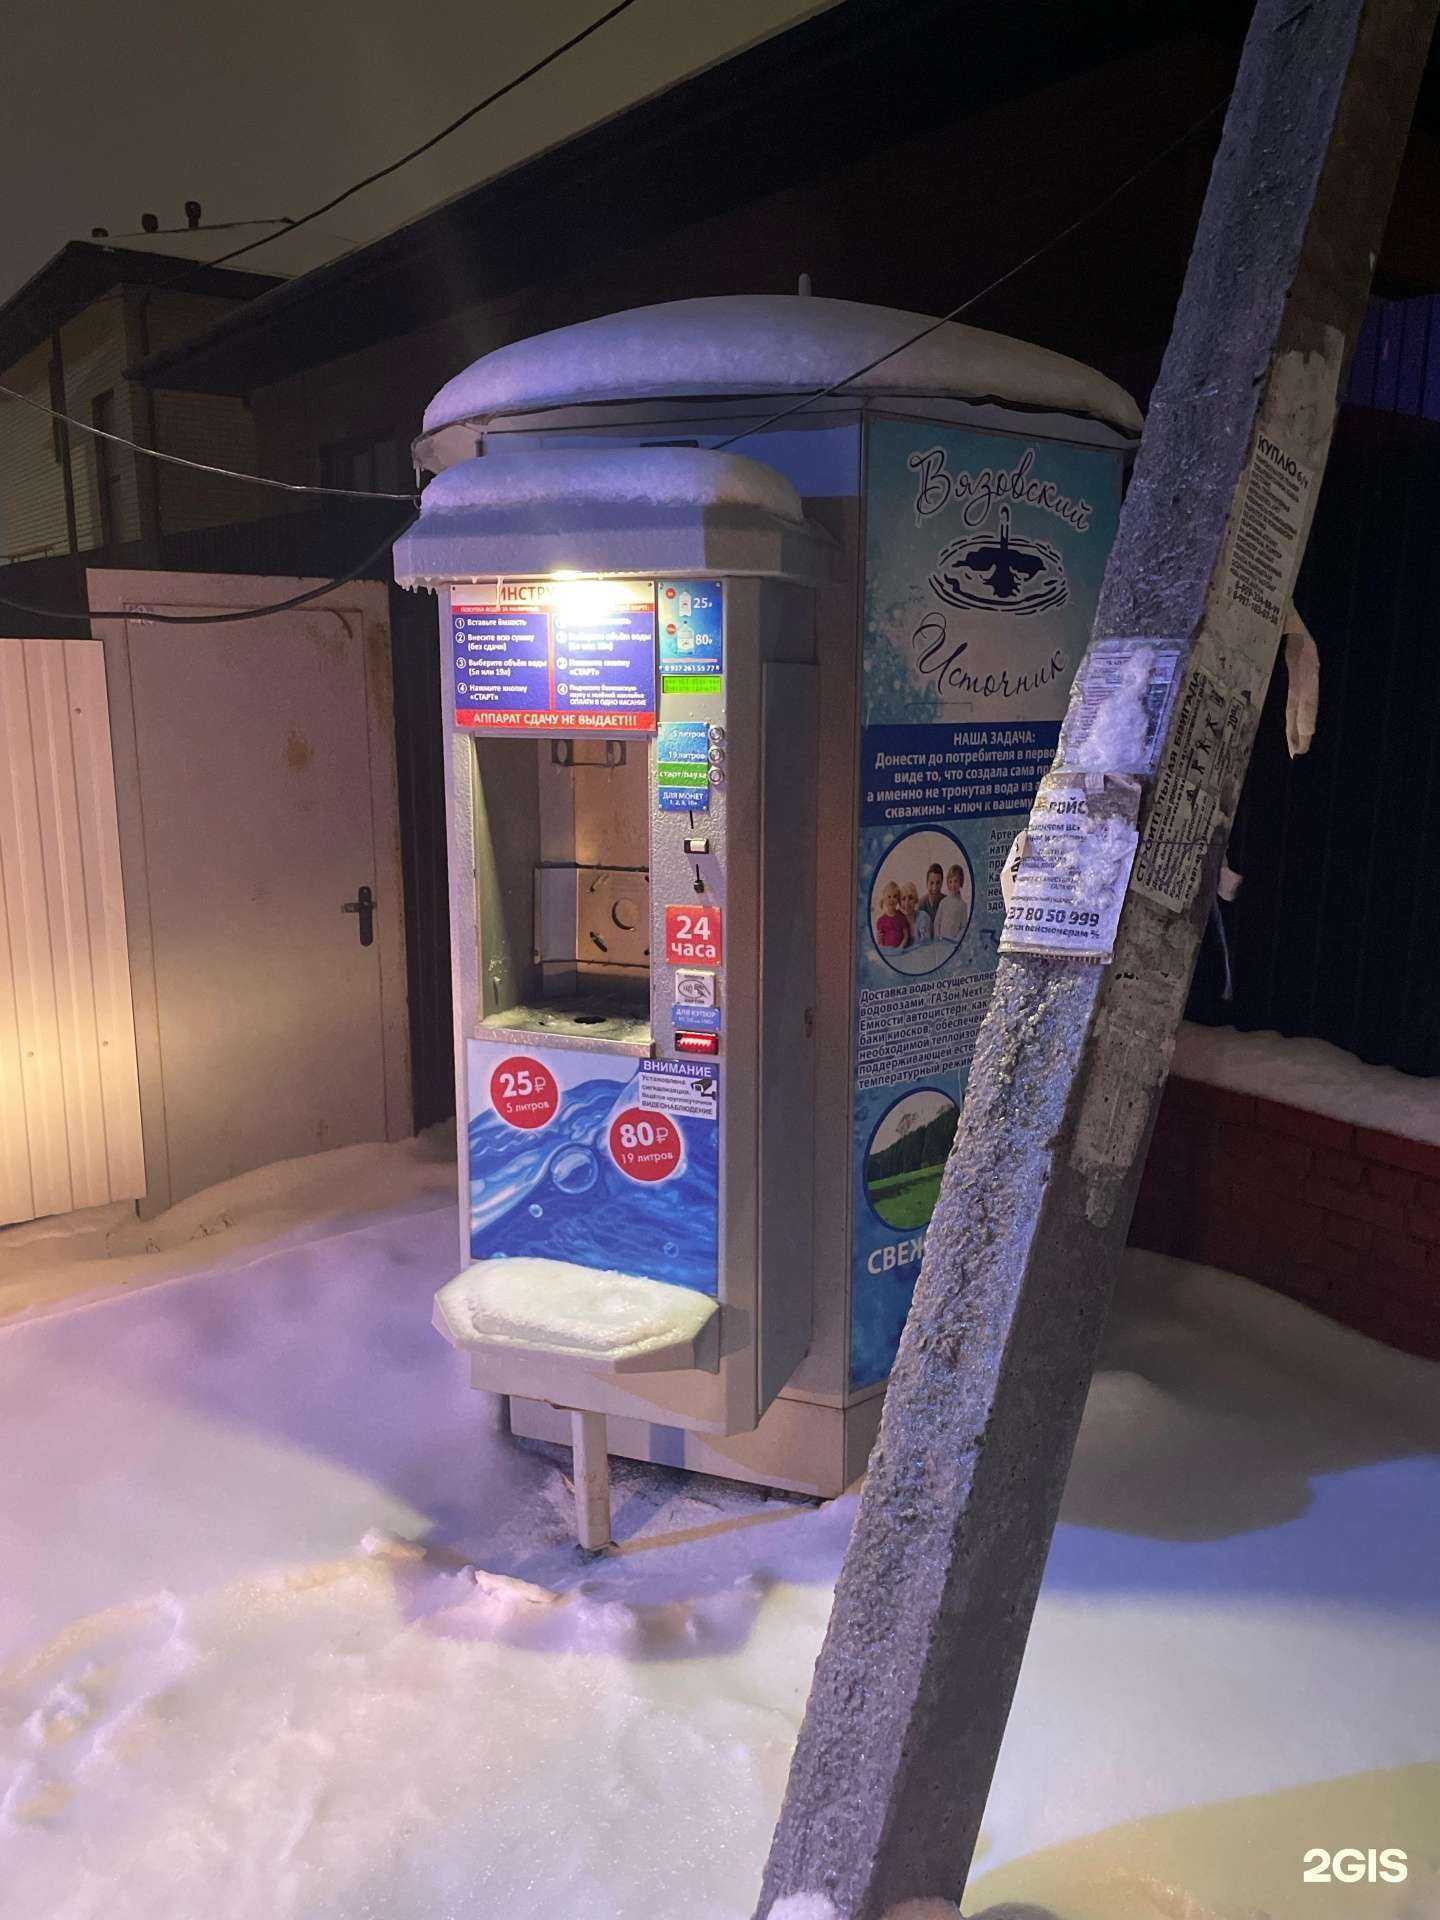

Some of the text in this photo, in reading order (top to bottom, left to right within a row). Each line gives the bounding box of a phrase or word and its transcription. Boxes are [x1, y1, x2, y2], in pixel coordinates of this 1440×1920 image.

[1258, 434, 1297, 477] КУПЛЮ
[909, 450, 1091, 530] Вязовский
[468, 659, 503, 668] Выберите
[911, 611, 1066, 698] Источник
[469, 684, 502, 692] Нажмите
[502, 685, 528, 693] кнопку
[473, 712, 522, 724] АППАРАТ
[523, 713, 559, 727] СДАЧУ
[561, 714, 576, 725] НЕ
[953, 731, 1036, 747] НАША ЗАДАЧА:
[875, 749, 1057, 769] Донести до потребителя в перво
[894, 771, 924, 785] виде
[926, 771, 941, 783] то,
[944, 769, 963, 780] что
[965, 767, 1008, 781] создала
[1010, 765, 1035, 776] сама
[662, 792, 704, 800] ДЛЯ МОНЕТ
[867, 791, 874, 802] а
[877, 789, 923, 802] именно
[925, 787, 939, 799] не
[942, 784, 993, 800] тронутая
[994, 783, 1019, 795] вода
[1021, 782, 1033, 792] из
[885, 804, 945, 819] скважины
[953, 802, 983, 814] ключ
[984, 801, 991, 811] к
[993, 798, 1034, 810] вашему
[990, 829, 1022, 841] Артези
[989, 845, 1011, 855] нату
[1025, 907, 1044, 921] 80
[1045, 909, 1066, 924] 50
[1068, 911, 1100, 927] 999
[675, 915, 711, 941] 24
[671, 942, 717, 958] часа
[861, 972, 997, 1003] Доставка воды осуществляет
[861, 998, 924, 1017] водовозами
[972, 1000, 987, 1010] как
[860, 1033, 885, 1046] баки
[936, 1014, 987, 1031] обеспечен
[860, 1029, 979, 1060] необходимой теплоизол
[643, 1060, 712, 1077] ВНИМАНИЕ
[860, 1048, 952, 1074] поддерживающей
[859, 1064, 940, 1089] температурный
[506, 1101, 550, 1114] 5 литров
[642, 1100, 712, 1115] ВИДЕОНАБЛЮДЕНИЕ
[620, 1151, 674, 1165] 19 литров
